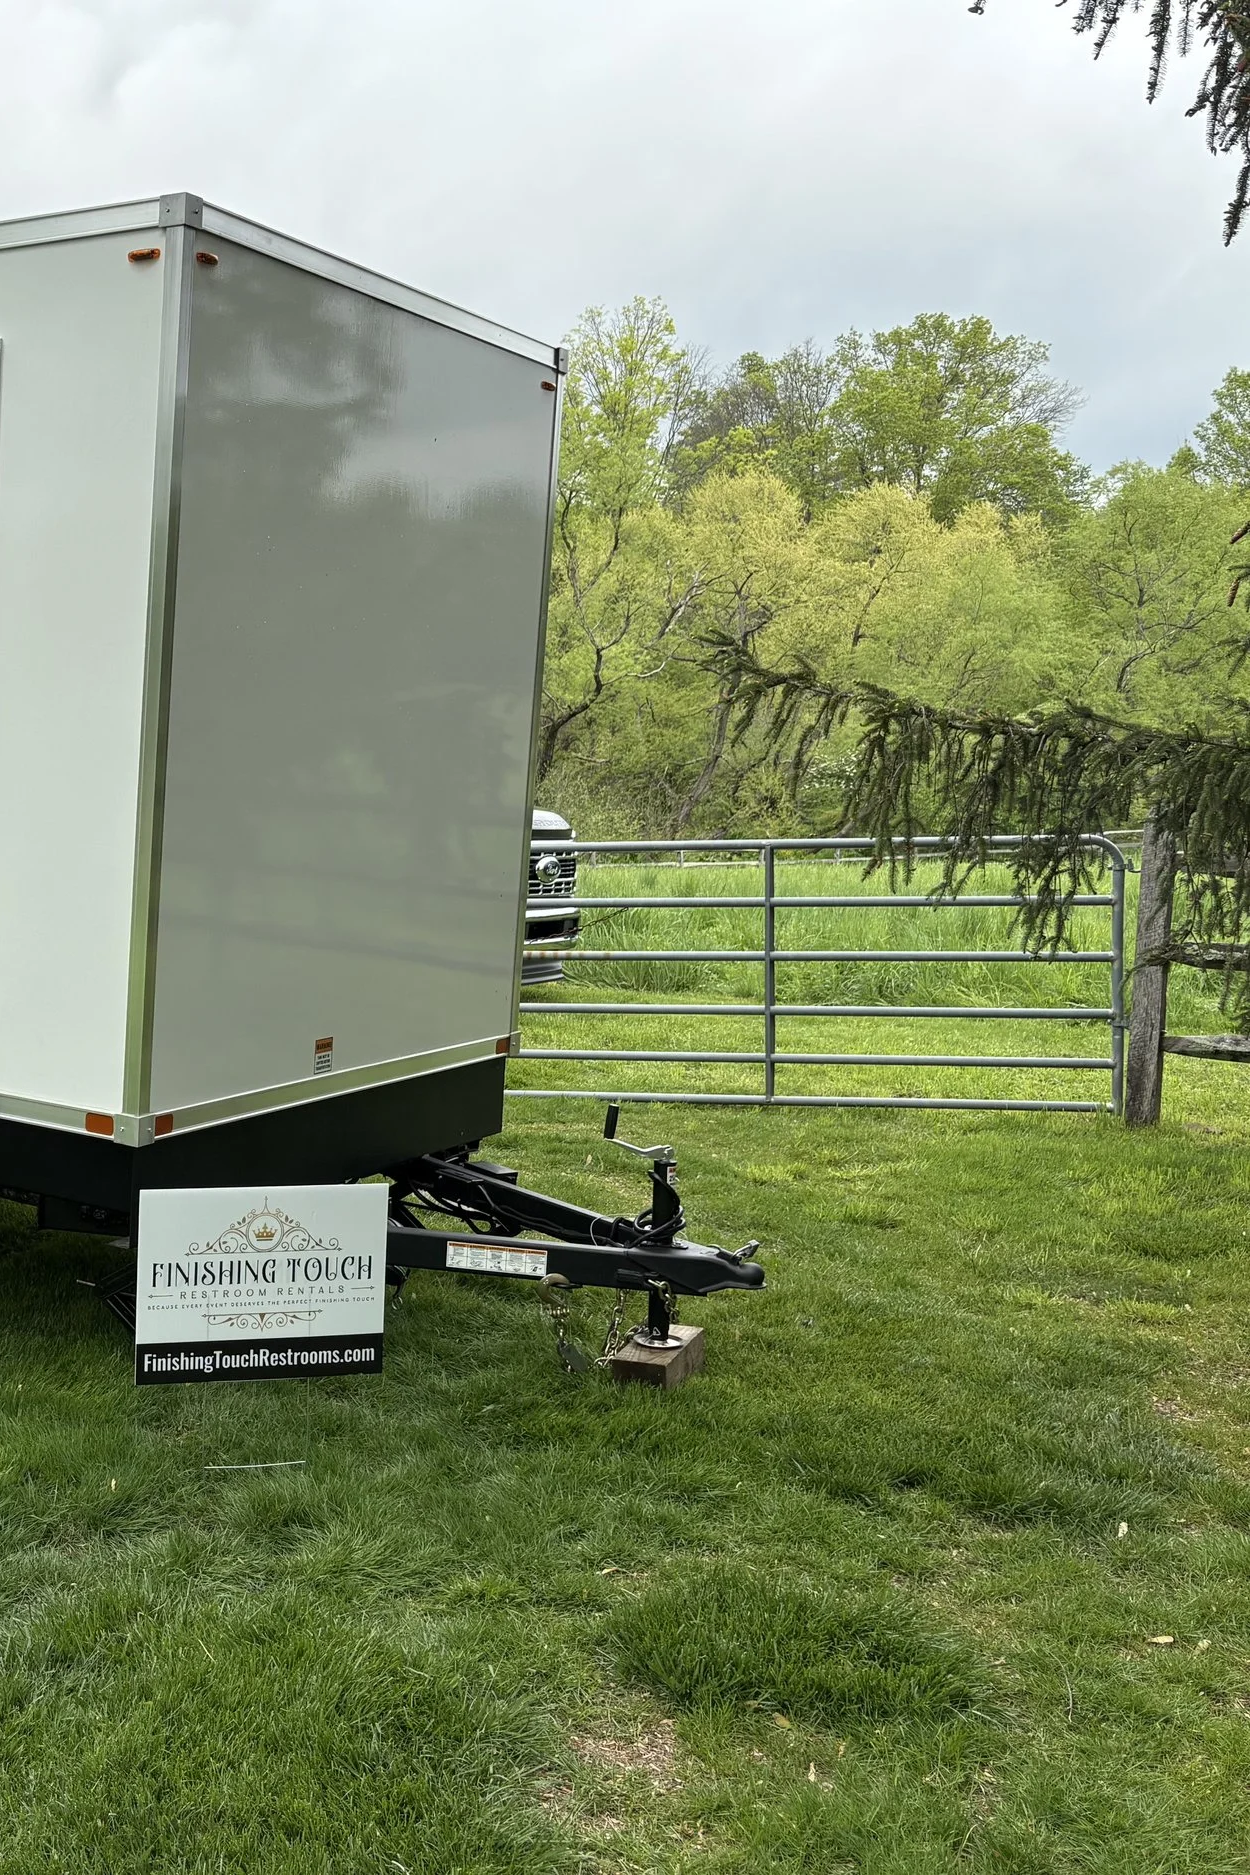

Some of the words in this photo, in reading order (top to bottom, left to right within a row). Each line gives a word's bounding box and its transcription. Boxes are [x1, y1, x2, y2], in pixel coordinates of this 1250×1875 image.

[152, 1259, 276, 1288] FINISHING
[287, 1255, 372, 1283] TOUCH
[180, 1288, 267, 1300] RESTROOM
[277, 1284, 345, 1296] RENTALS
[143, 1347, 375, 1373] FinishingTouchRestrooms.com
